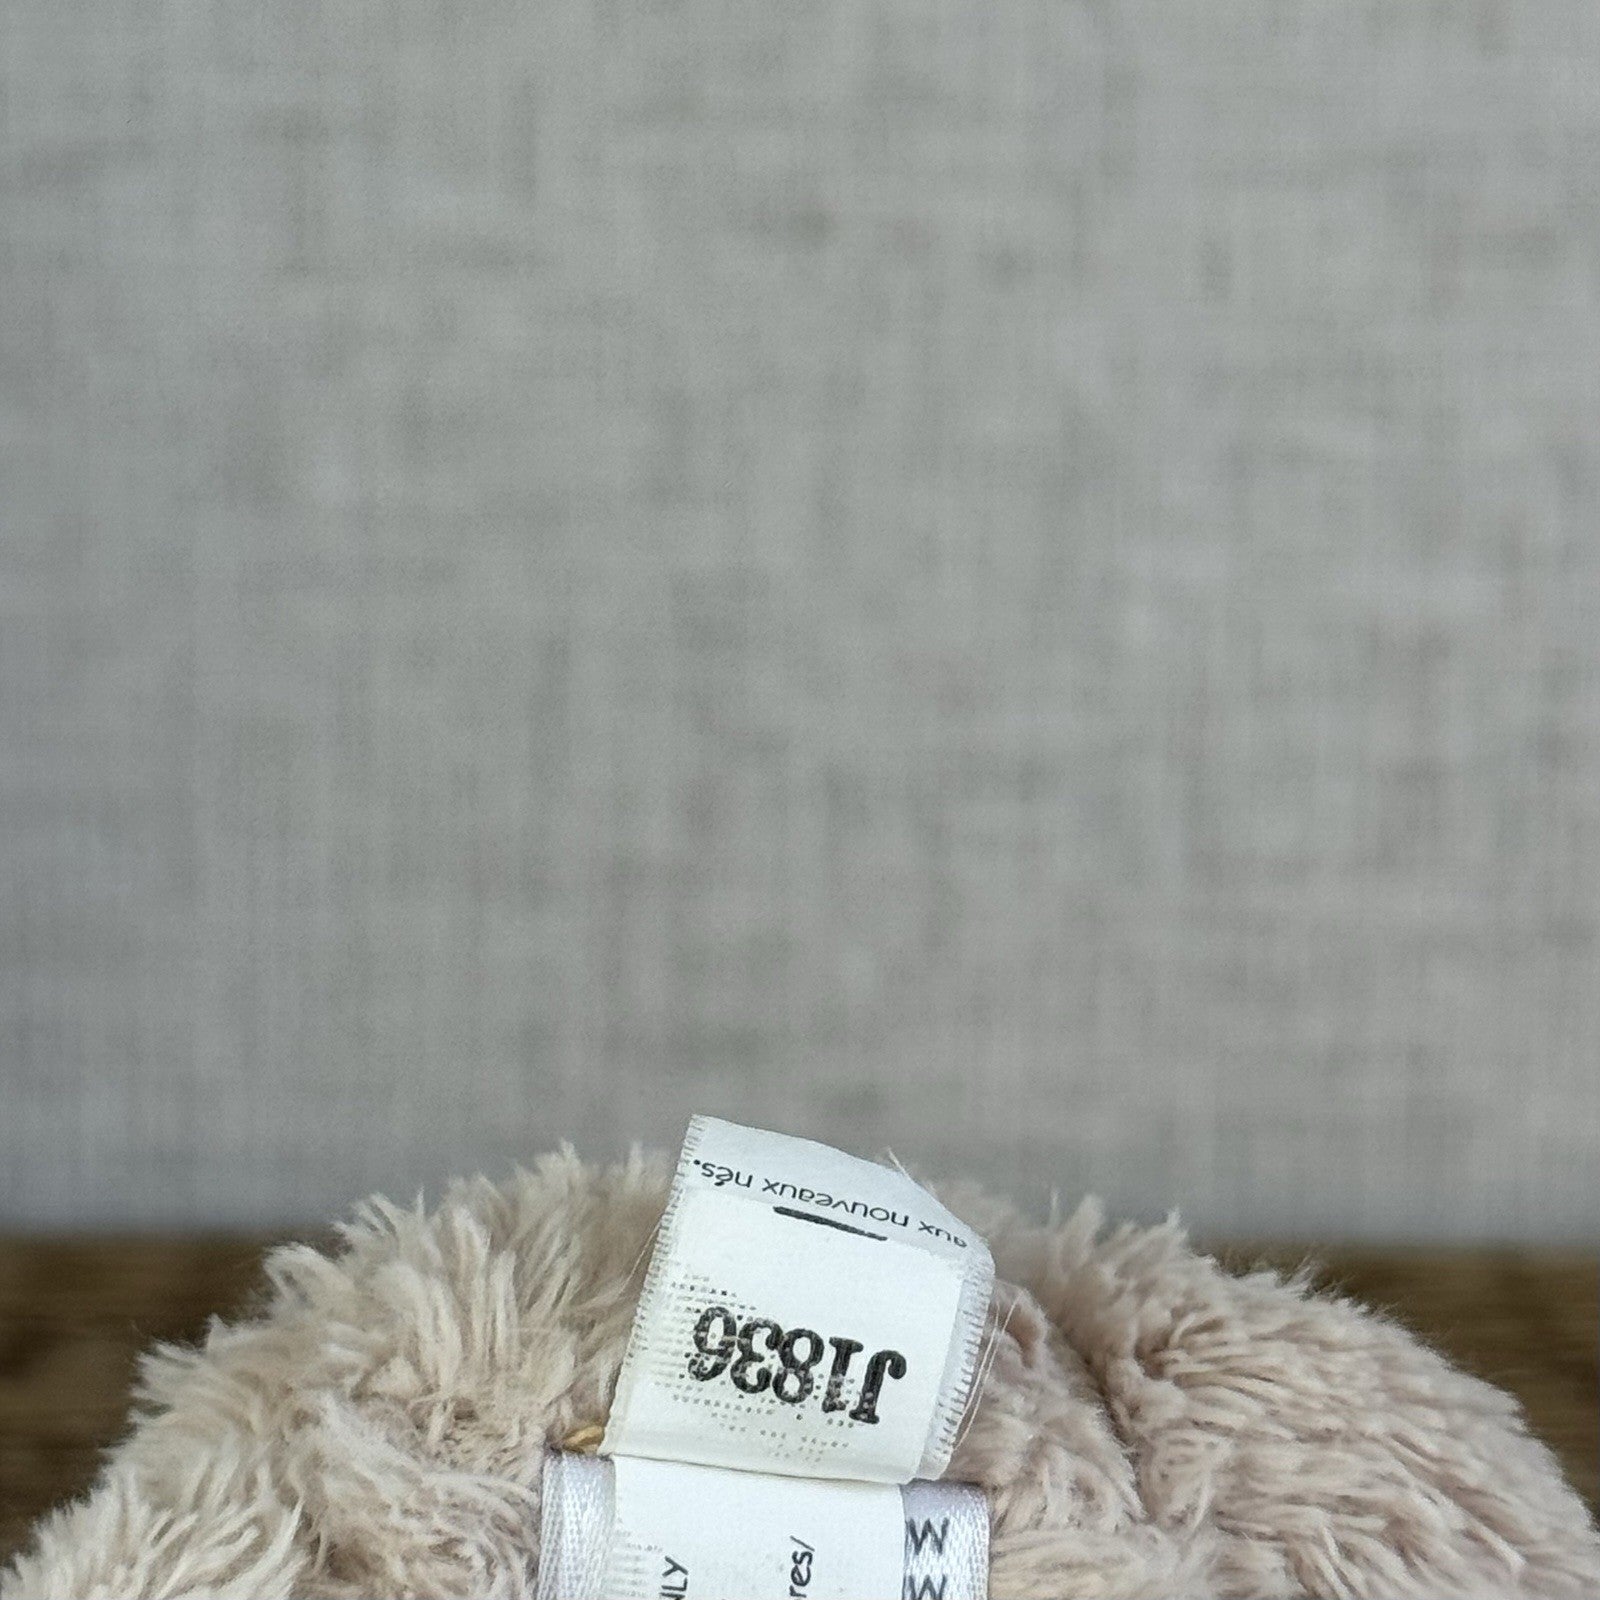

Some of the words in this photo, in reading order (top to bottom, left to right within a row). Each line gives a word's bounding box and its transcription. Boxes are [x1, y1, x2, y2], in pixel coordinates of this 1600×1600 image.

[693, 1159, 753, 1187] nés.
[762, 1178, 909, 1228] nouveaux
[918, 1220, 968, 1248] aux
[688, 1306, 907, 1424] J1836
[789, 1535, 815, 1600] res/
